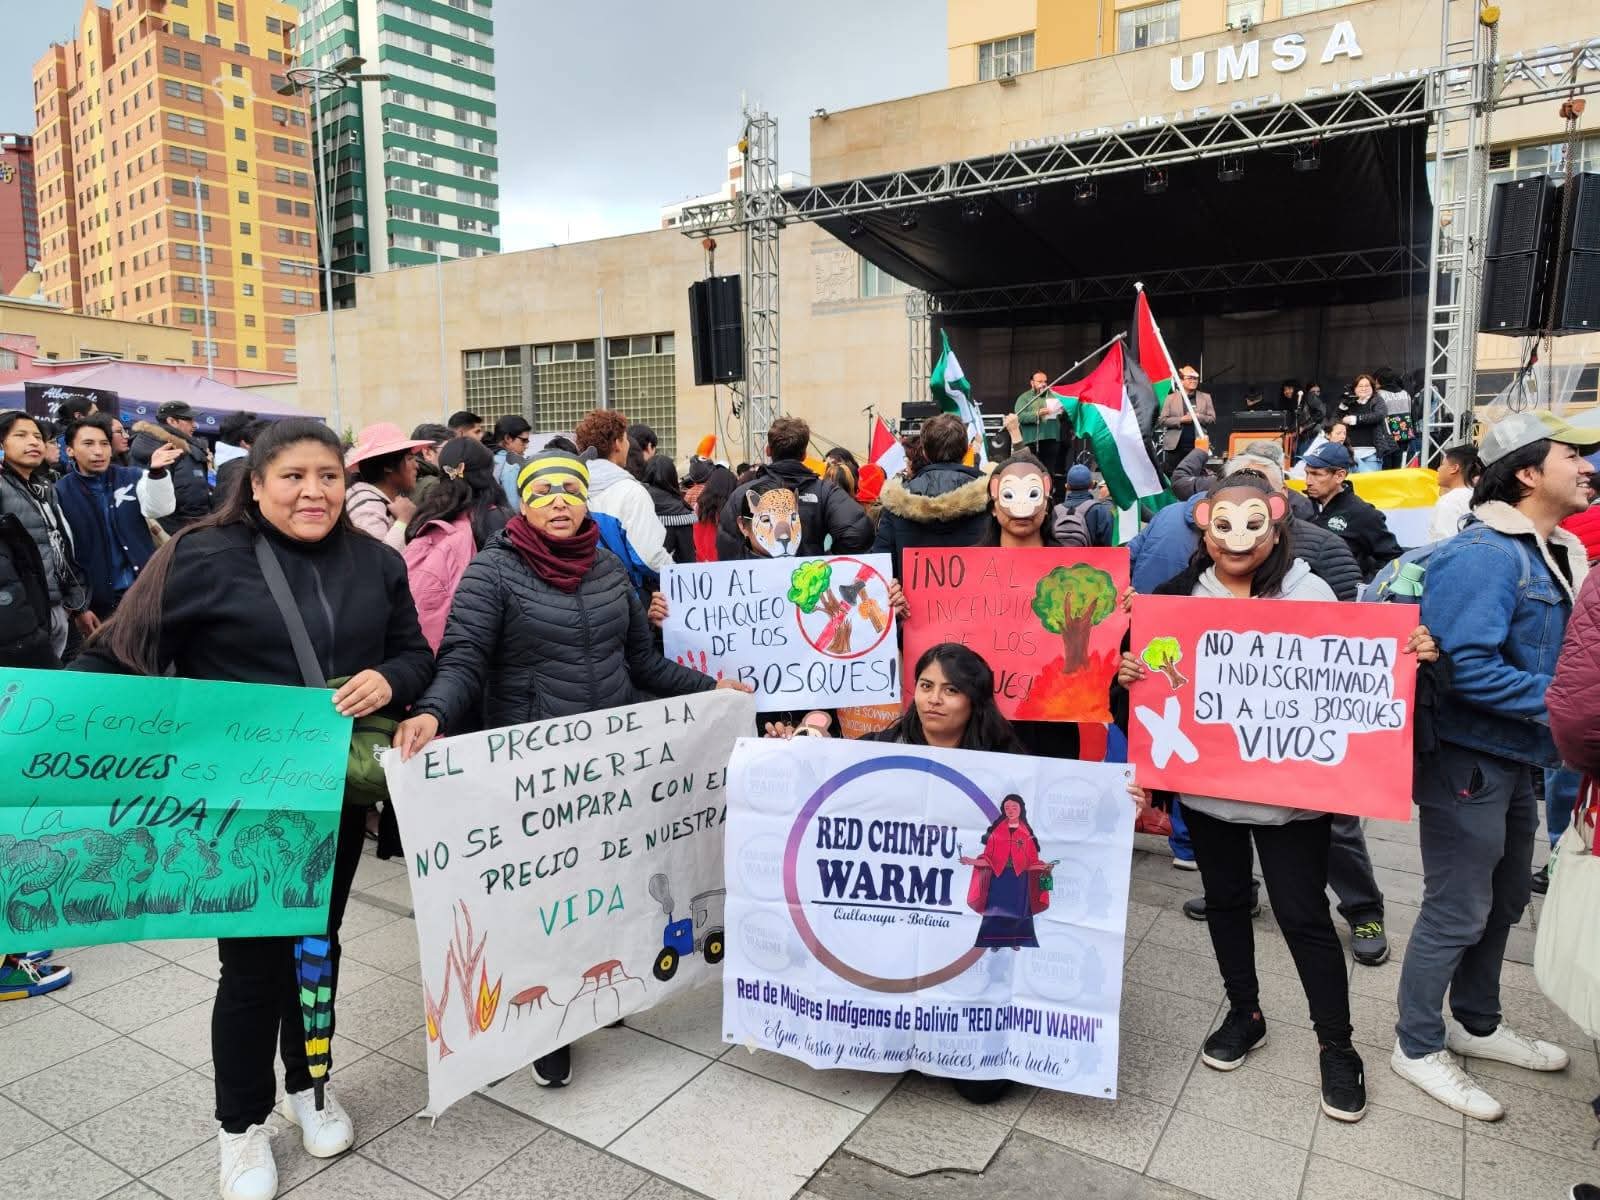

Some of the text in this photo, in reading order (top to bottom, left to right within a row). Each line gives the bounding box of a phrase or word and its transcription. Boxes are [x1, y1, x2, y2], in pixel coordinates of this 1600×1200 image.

[1170, 20, 1363, 92] UMSA
[670, 569, 761, 602] ¡NO AL
[912, 552, 1022, 590] ¡NO AL
[685, 597, 785, 632] CHAQUEO
[927, 592, 1033, 625] INCENDIO
[712, 627, 788, 656] DE LOS
[993, 629, 1036, 656] LOS
[1205, 633, 1389, 667] NO A LA TALA
[738, 657, 897, 698] BOSQUES!
[1218, 663, 1390, 699] INDISCRIMINADA
[225, 711, 329, 743] nuestros
[1195, 691, 1403, 729] SI A LOS BOSQUES
[425, 702, 695, 779] EL PRECIO DE LA
[1239, 725, 1337, 762] VIVOS
[22, 752, 178, 780] BOSQUES
[181, 762, 220, 784] es
[515, 741, 675, 801] MINERIA
[22, 796, 66, 834] la
[416, 841, 449, 878] NO
[463, 825, 503, 858] SE
[522, 788, 632, 837] COMPARA
[651, 773, 694, 802] CON
[816, 816, 957, 859] RED CHIMPU
[480, 846, 579, 894] PRECIO
[600, 839, 632, 862] DE
[816, 859, 954, 906] WARMI
[539, 883, 625, 936] VIDA
[834, 907, 896, 927] Qullasuyu
[907, 912, 950, 928] Bolivia
[737, 977, 1103, 1044] Red de Mujeres Indígenas de Bolivia "RED CHIMPU WARMI"
[804, 1032, 832, 1057] tierra
[834, 1043, 846, 1064] y
[881, 1040, 934, 1063] nuestras
[937, 1048, 975, 1071] raíces,
[979, 1046, 1020, 1066] nuestra
